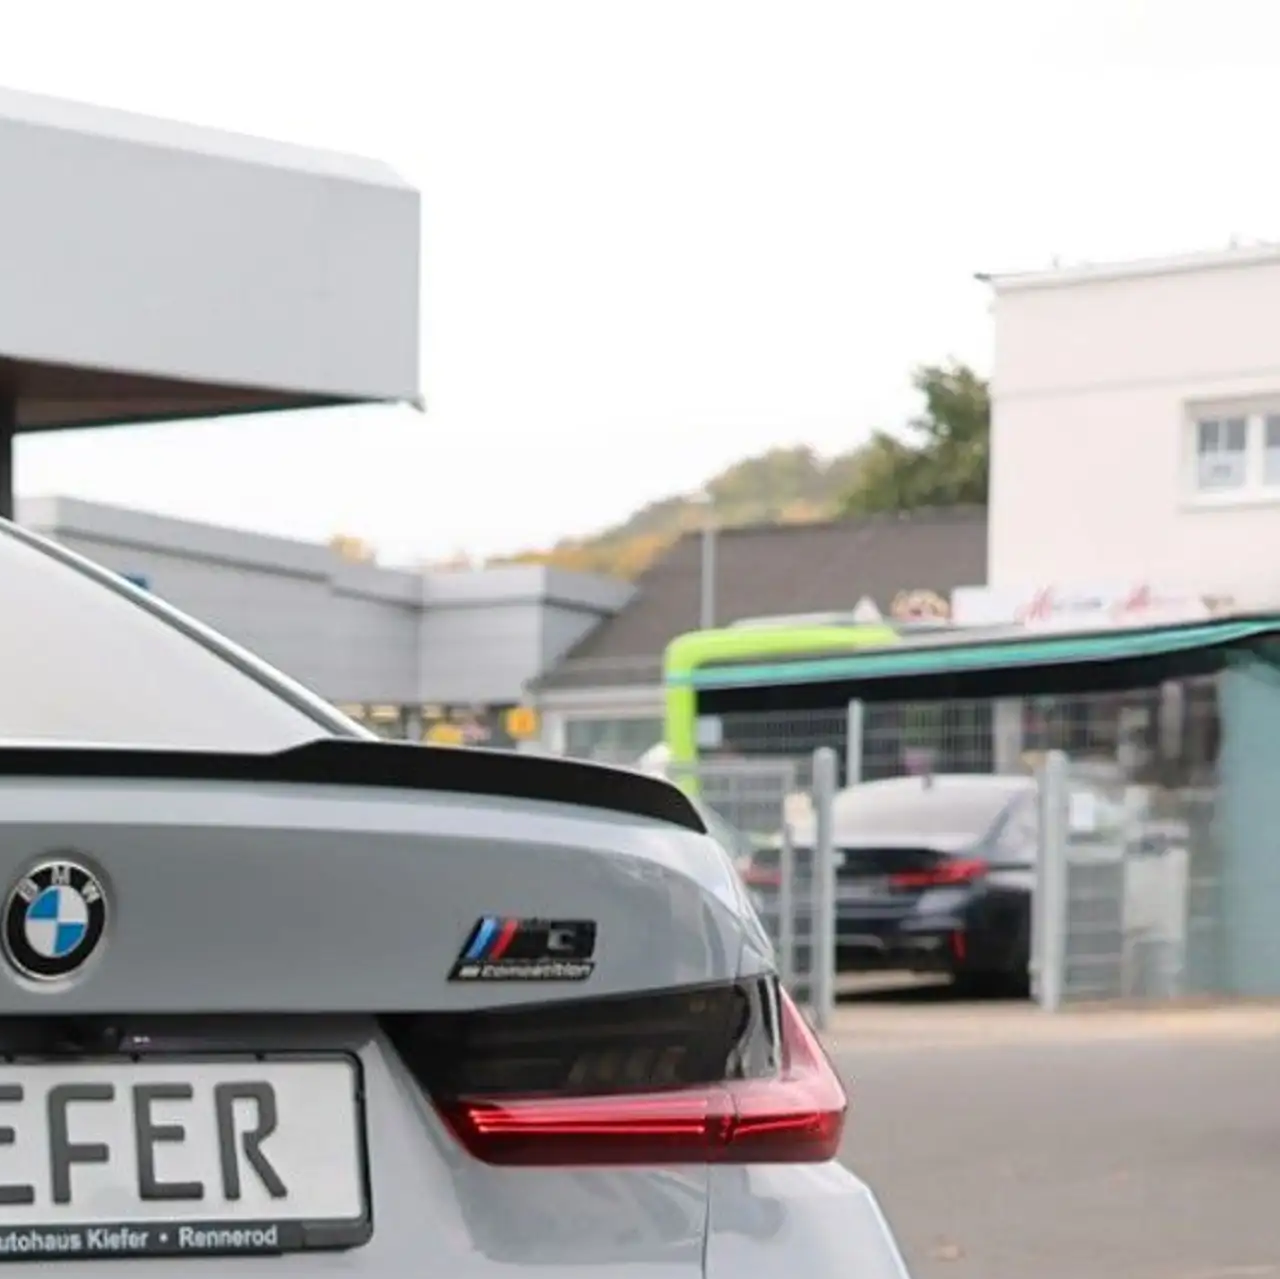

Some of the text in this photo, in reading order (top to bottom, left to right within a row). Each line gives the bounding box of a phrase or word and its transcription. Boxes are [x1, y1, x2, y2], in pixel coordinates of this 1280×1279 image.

[16, 864, 101, 902] BMW
[87, 1228, 149, 1249] Kiefer
[178, 1225, 278, 1248] Rennerod
